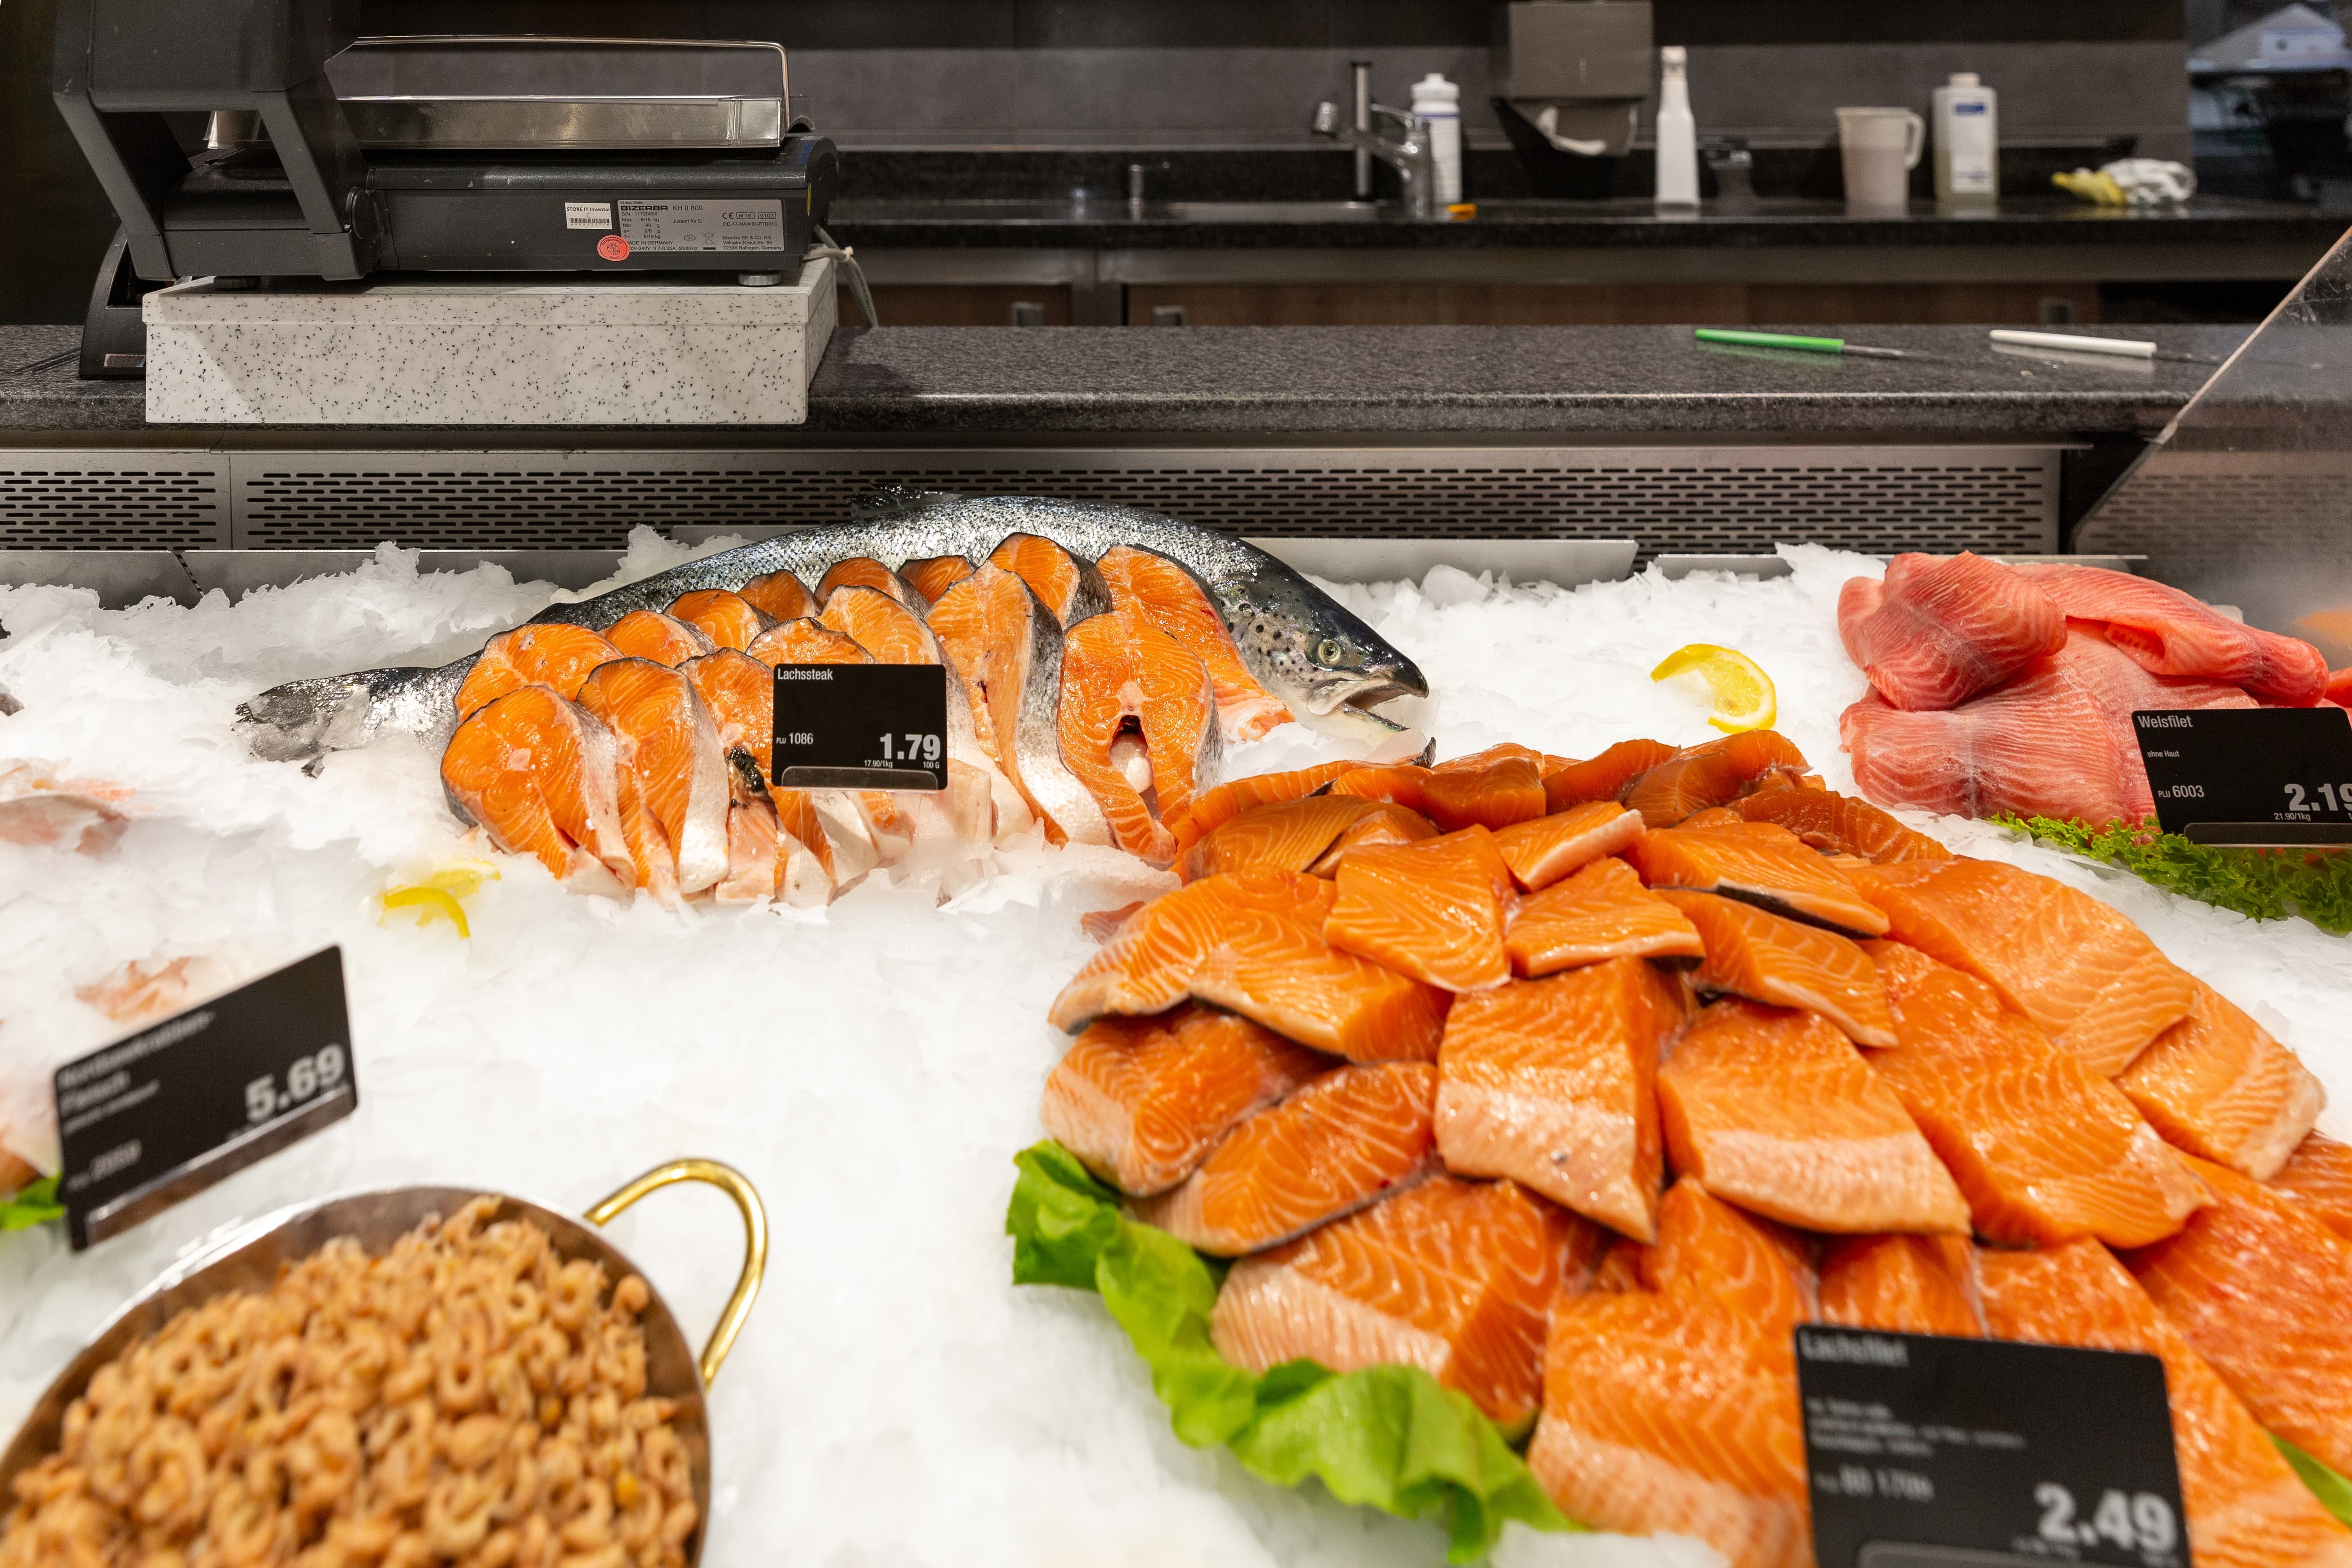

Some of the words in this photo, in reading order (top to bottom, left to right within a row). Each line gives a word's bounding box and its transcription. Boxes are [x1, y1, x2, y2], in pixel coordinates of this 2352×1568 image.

[778, 668, 833, 680] Lachssteak
[2137, 716, 2193, 728] Welsfilet
[789, 732, 813, 745] 1086
[880, 733, 941, 761] 1.79
[864, 760, 893, 769] 17.90/1kg
[2172, 785, 2204, 798] 6003
[2284, 783, 2352, 812] 2.19
[2274, 812, 2311, 821] 21.90/1kg
[245, 1043, 346, 1122] 5.69
[2034, 1482, 2178, 1552] 2.49
